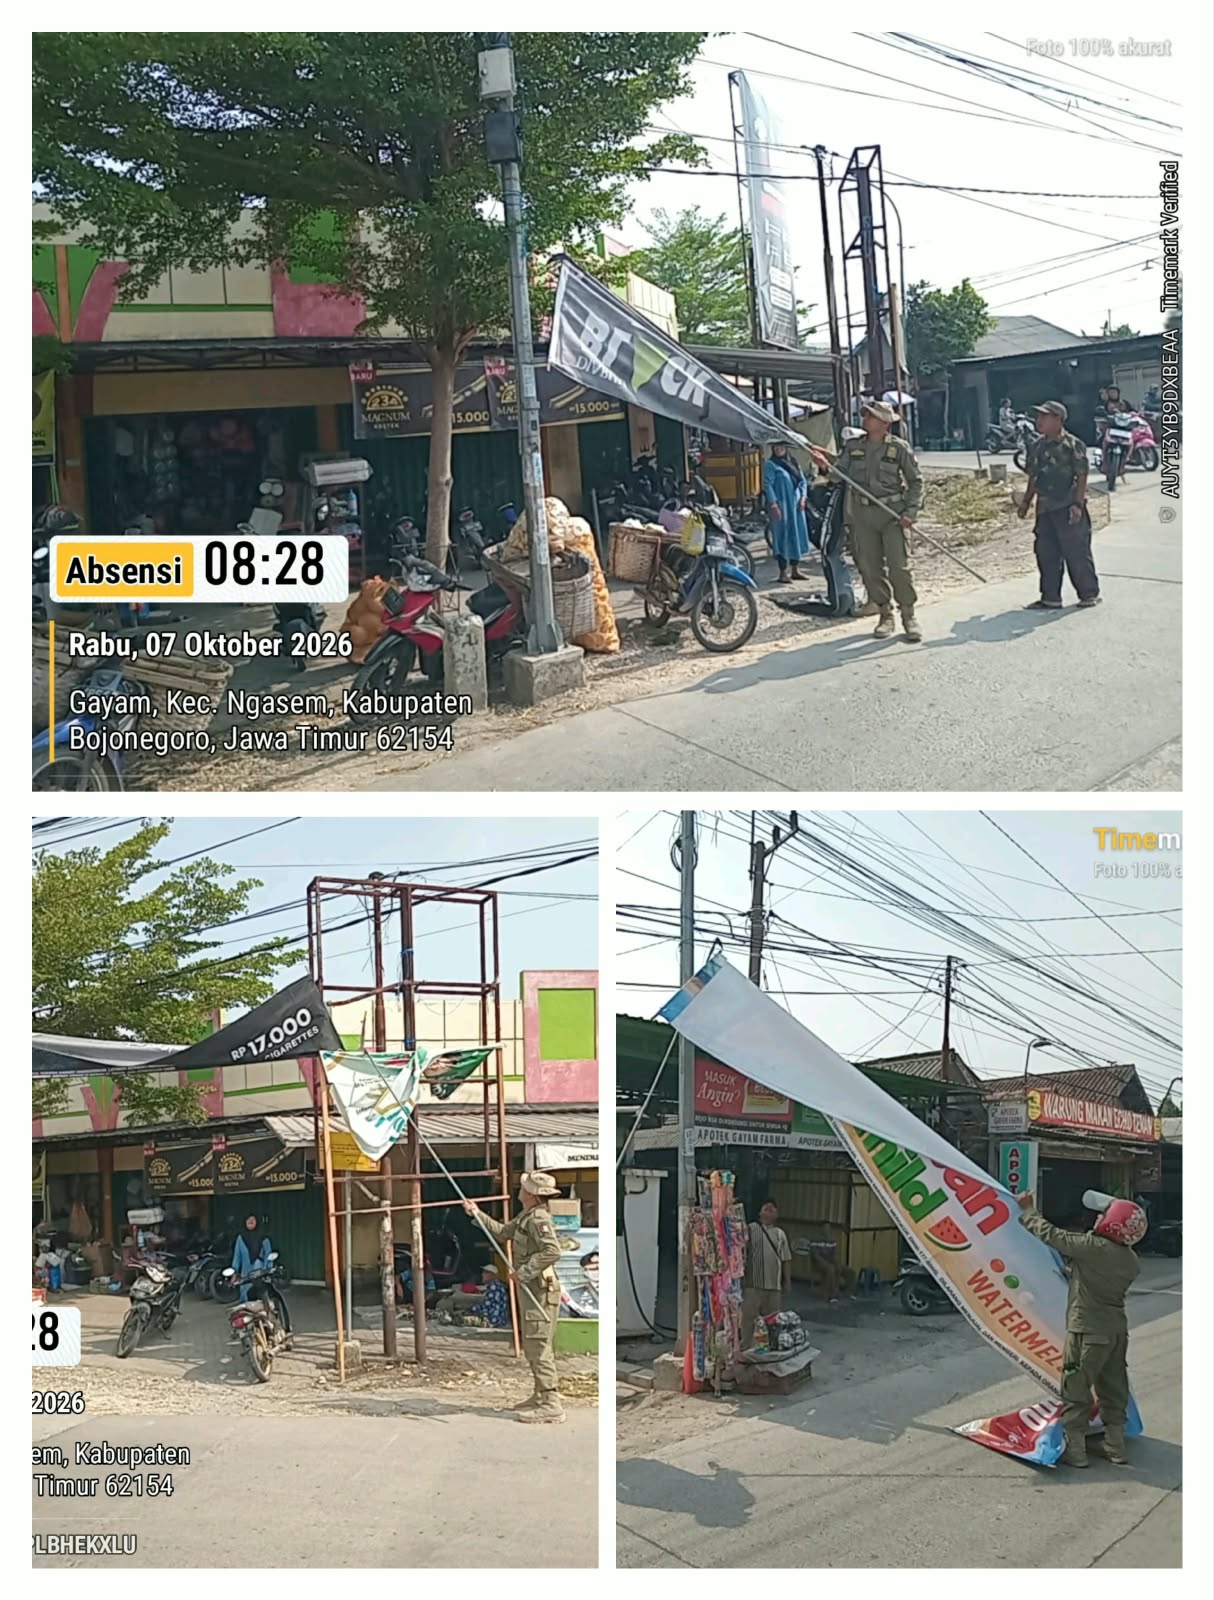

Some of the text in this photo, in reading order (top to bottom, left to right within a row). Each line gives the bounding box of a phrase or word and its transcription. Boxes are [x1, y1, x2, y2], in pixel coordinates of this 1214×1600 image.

[371, 395, 398, 407] 234
[361, 411, 411, 423] MAGNUM
[231, 1008, 311, 1061] RP 17.000
[705, 1071, 737, 1087] MASUK
[696, 1082, 741, 1107] Angin?
[1044, 1093, 1084, 1122] WARUNG
[1085, 1101, 1113, 1128] MAKAN
[698, 1129, 786, 1145] APOTEK GAYAM FARMA
[931, 1159, 1010, 1236] an
